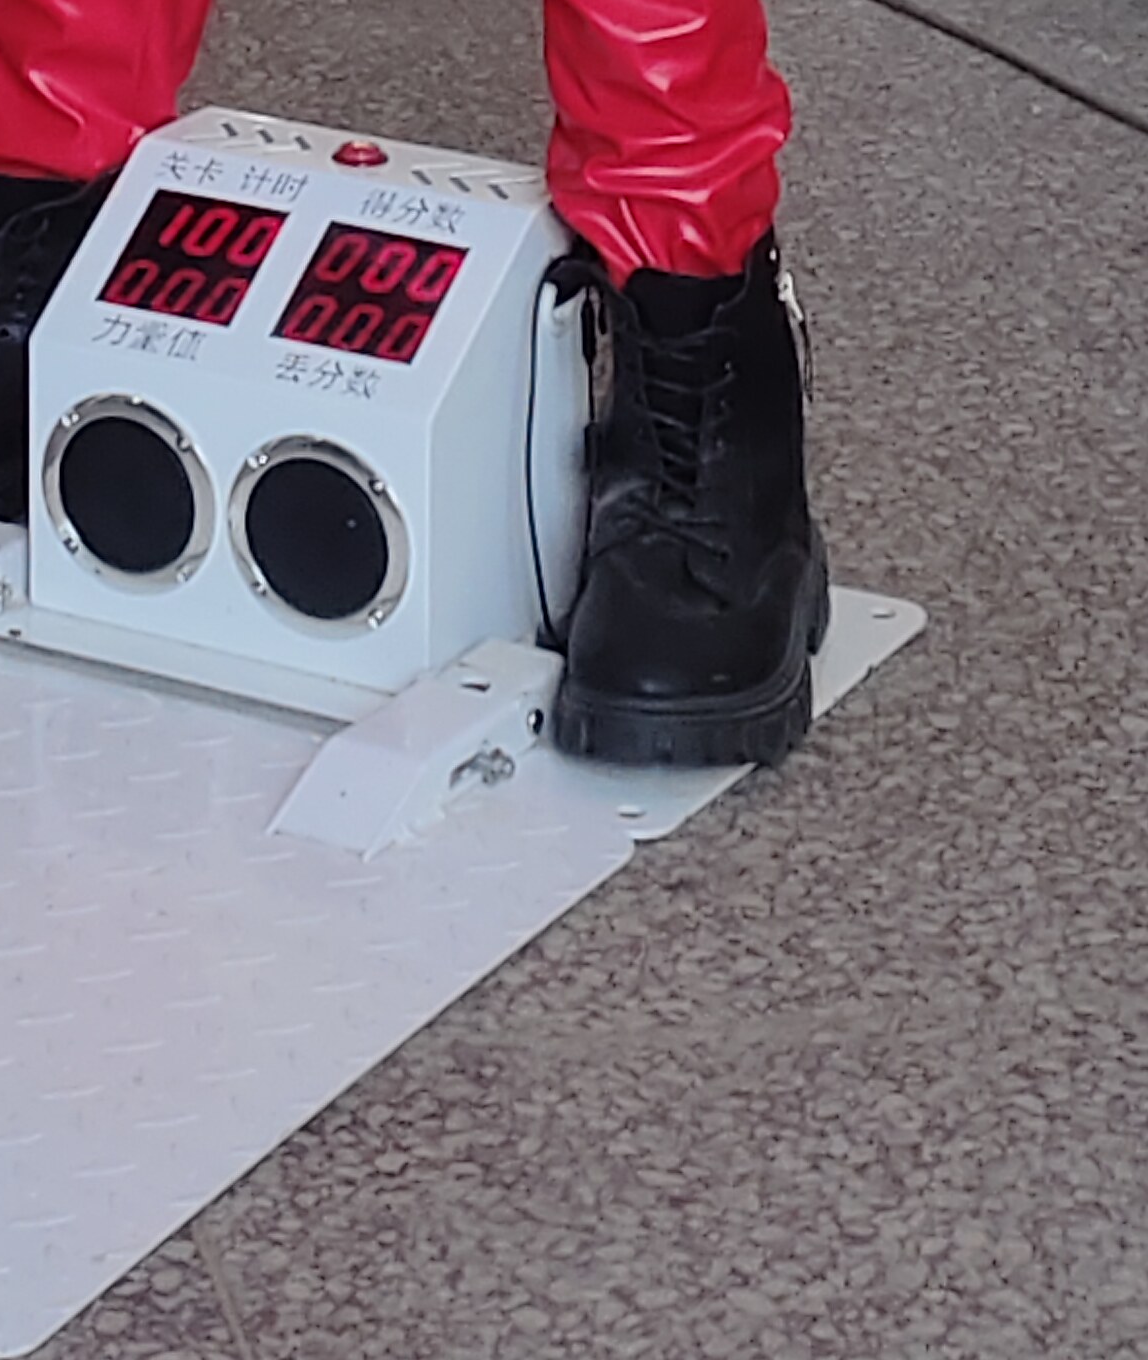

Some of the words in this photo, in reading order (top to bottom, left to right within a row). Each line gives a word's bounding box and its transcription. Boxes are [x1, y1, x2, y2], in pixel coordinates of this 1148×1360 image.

[157, 150, 224, 184] 关卡
[240, 165, 309, 203] 计时
[158, 203, 284, 267] 100
[360, 191, 466, 234] 得分数
[91, 314, 207, 361] 力量值
